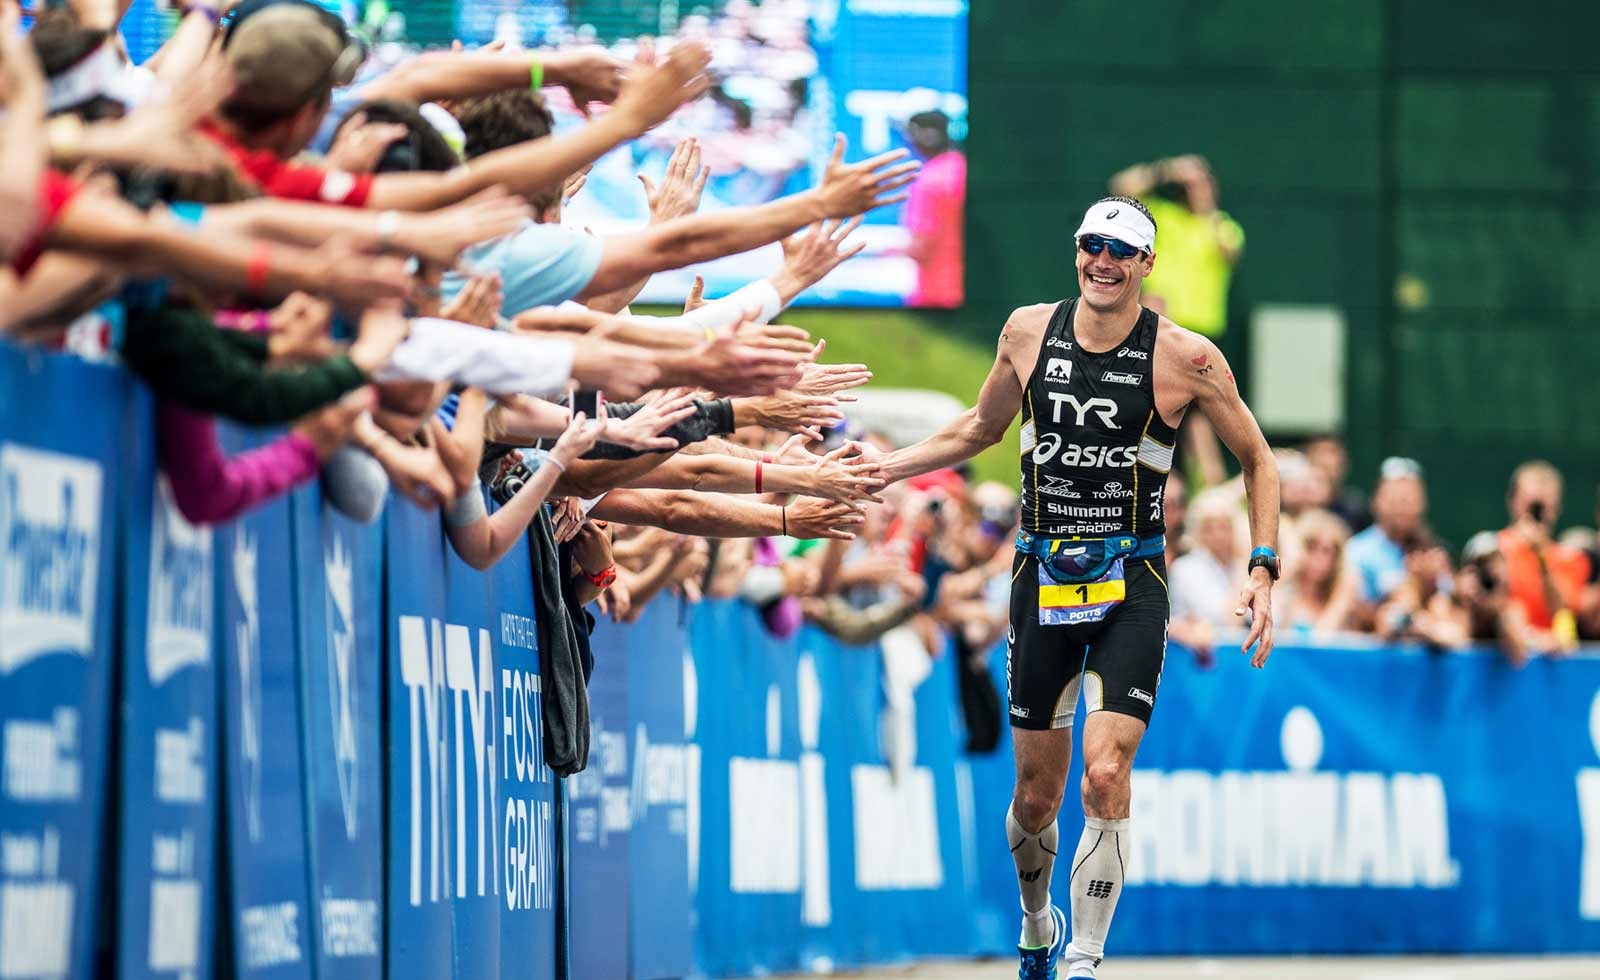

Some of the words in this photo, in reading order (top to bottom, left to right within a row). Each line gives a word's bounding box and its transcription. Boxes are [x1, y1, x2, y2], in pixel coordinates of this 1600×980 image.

[1044, 376, 1070, 385] NATHAN
[1048, 391, 1120, 429] TYR
[1061, 443, 1138, 468] asics
[1092, 489, 1134, 499] TOYOTA
[1047, 503, 1123, 518] SHIMANO
[1075, 585, 1088, 604] 1
[1069, 609, 1101, 620] POTTS
[502, 668, 551, 784] FOSTE
[445, 623, 498, 899] TYR
[1130, 769, 1452, 888] RONMAN
[1086, 891, 1110, 899] cep
